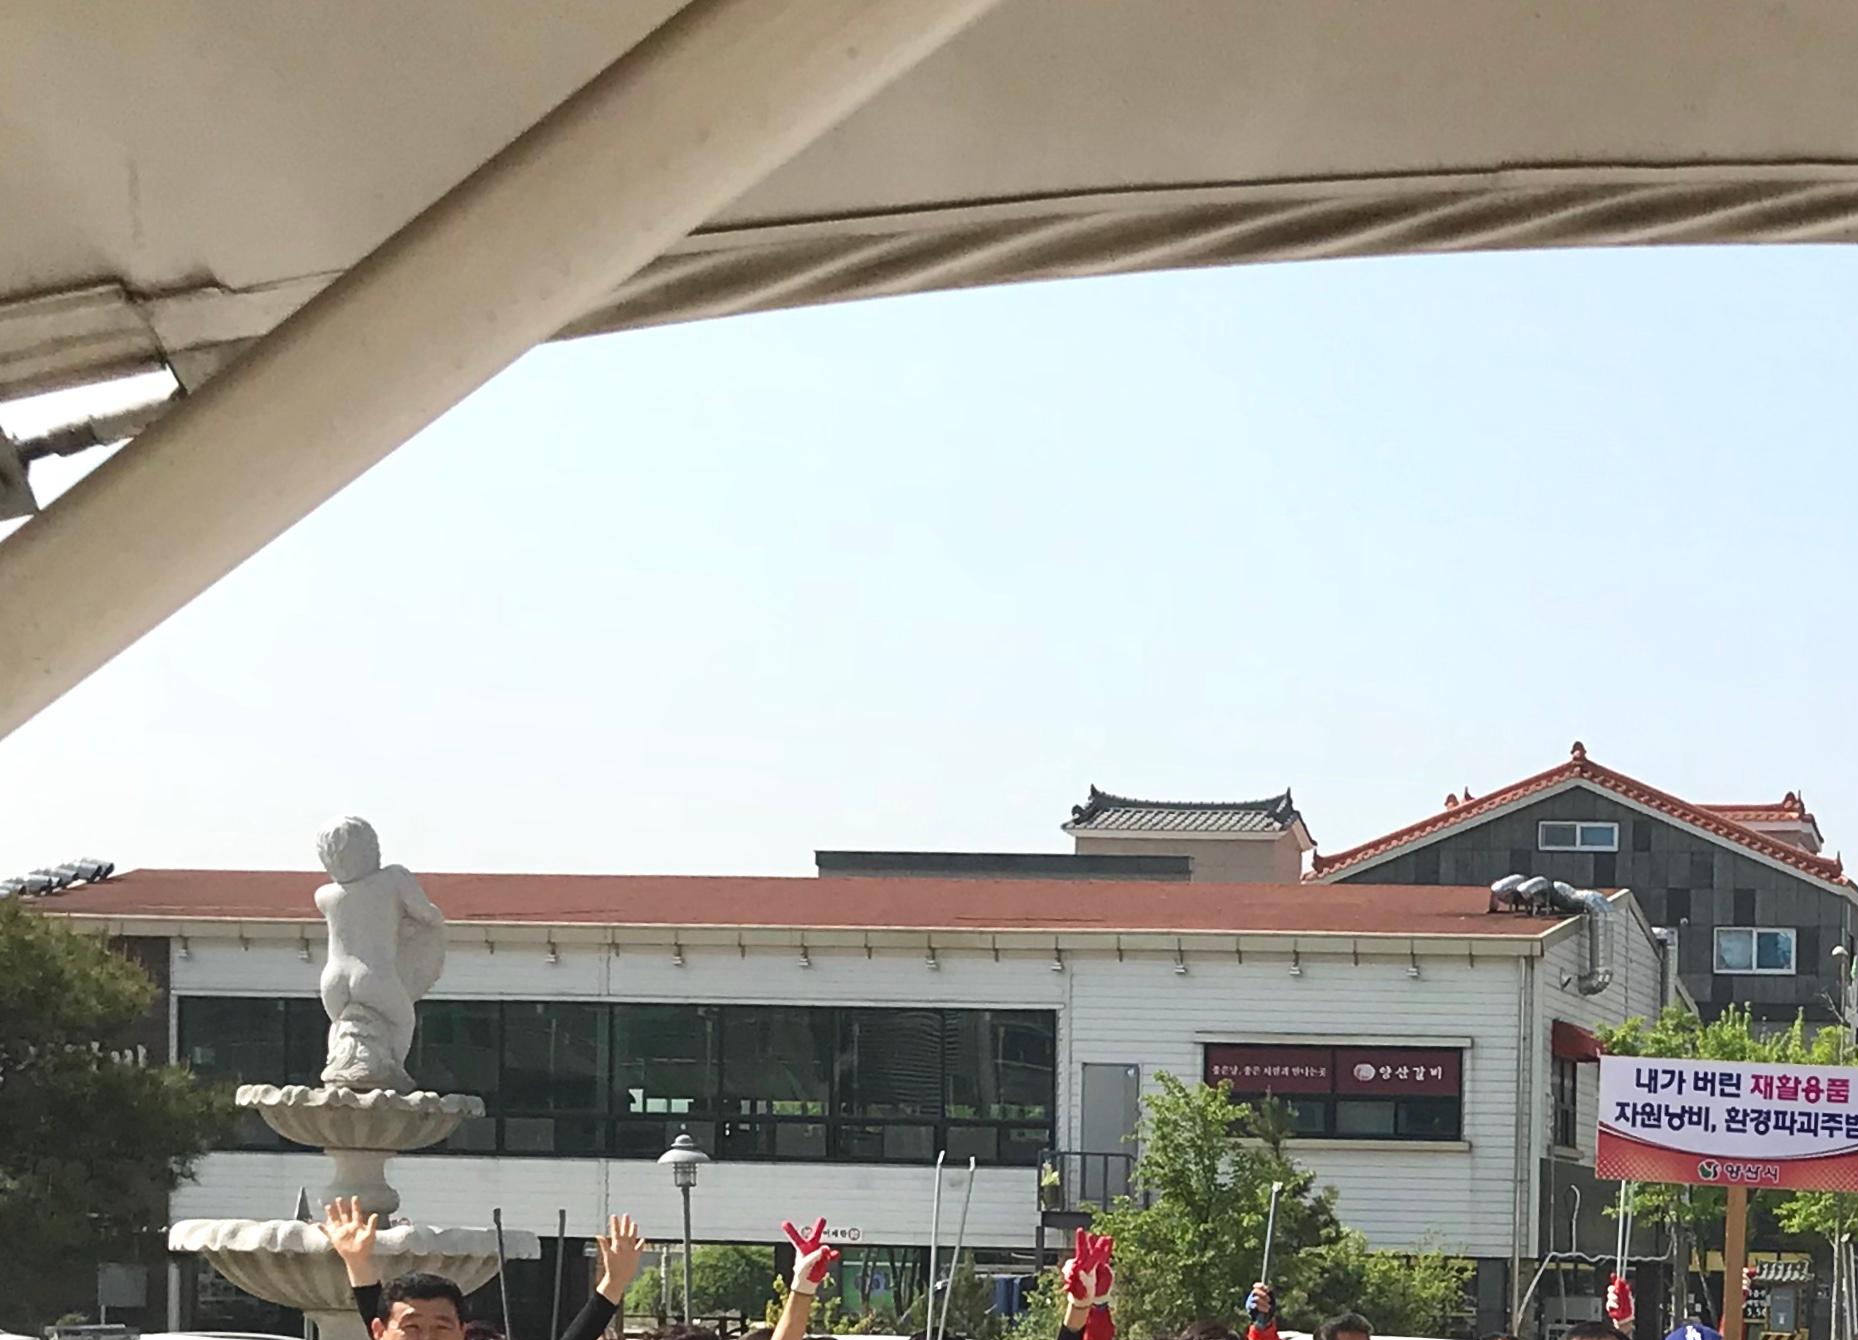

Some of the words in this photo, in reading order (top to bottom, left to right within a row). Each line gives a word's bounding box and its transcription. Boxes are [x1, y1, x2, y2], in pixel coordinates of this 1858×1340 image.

[1379, 1065, 1442, 1080] 양산갈비
[1635, 1068, 1686, 1095] 내가
[1693, 1071, 1742, 1099] 버린
[1750, 1074, 1850, 1104] 재활용품
[1615, 1101, 1717, 1133] 자원낭비,
[1725, 1163, 1780, 1182] 양산시
